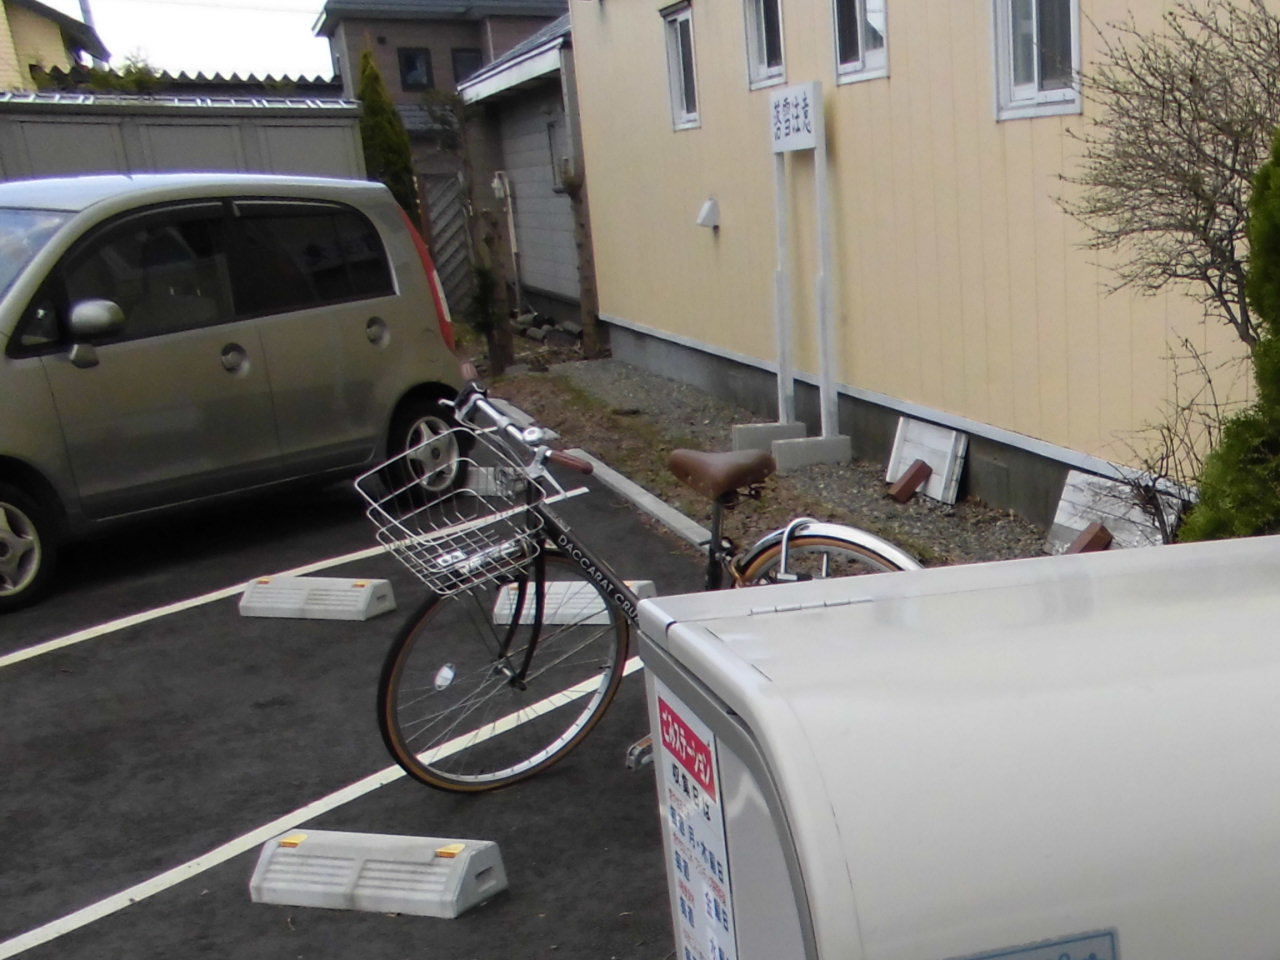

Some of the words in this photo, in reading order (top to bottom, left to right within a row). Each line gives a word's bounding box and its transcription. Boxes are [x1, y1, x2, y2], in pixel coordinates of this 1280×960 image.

[558, 534, 614, 596] DACCARAT
[662, 710, 711, 785] ごみステーション
